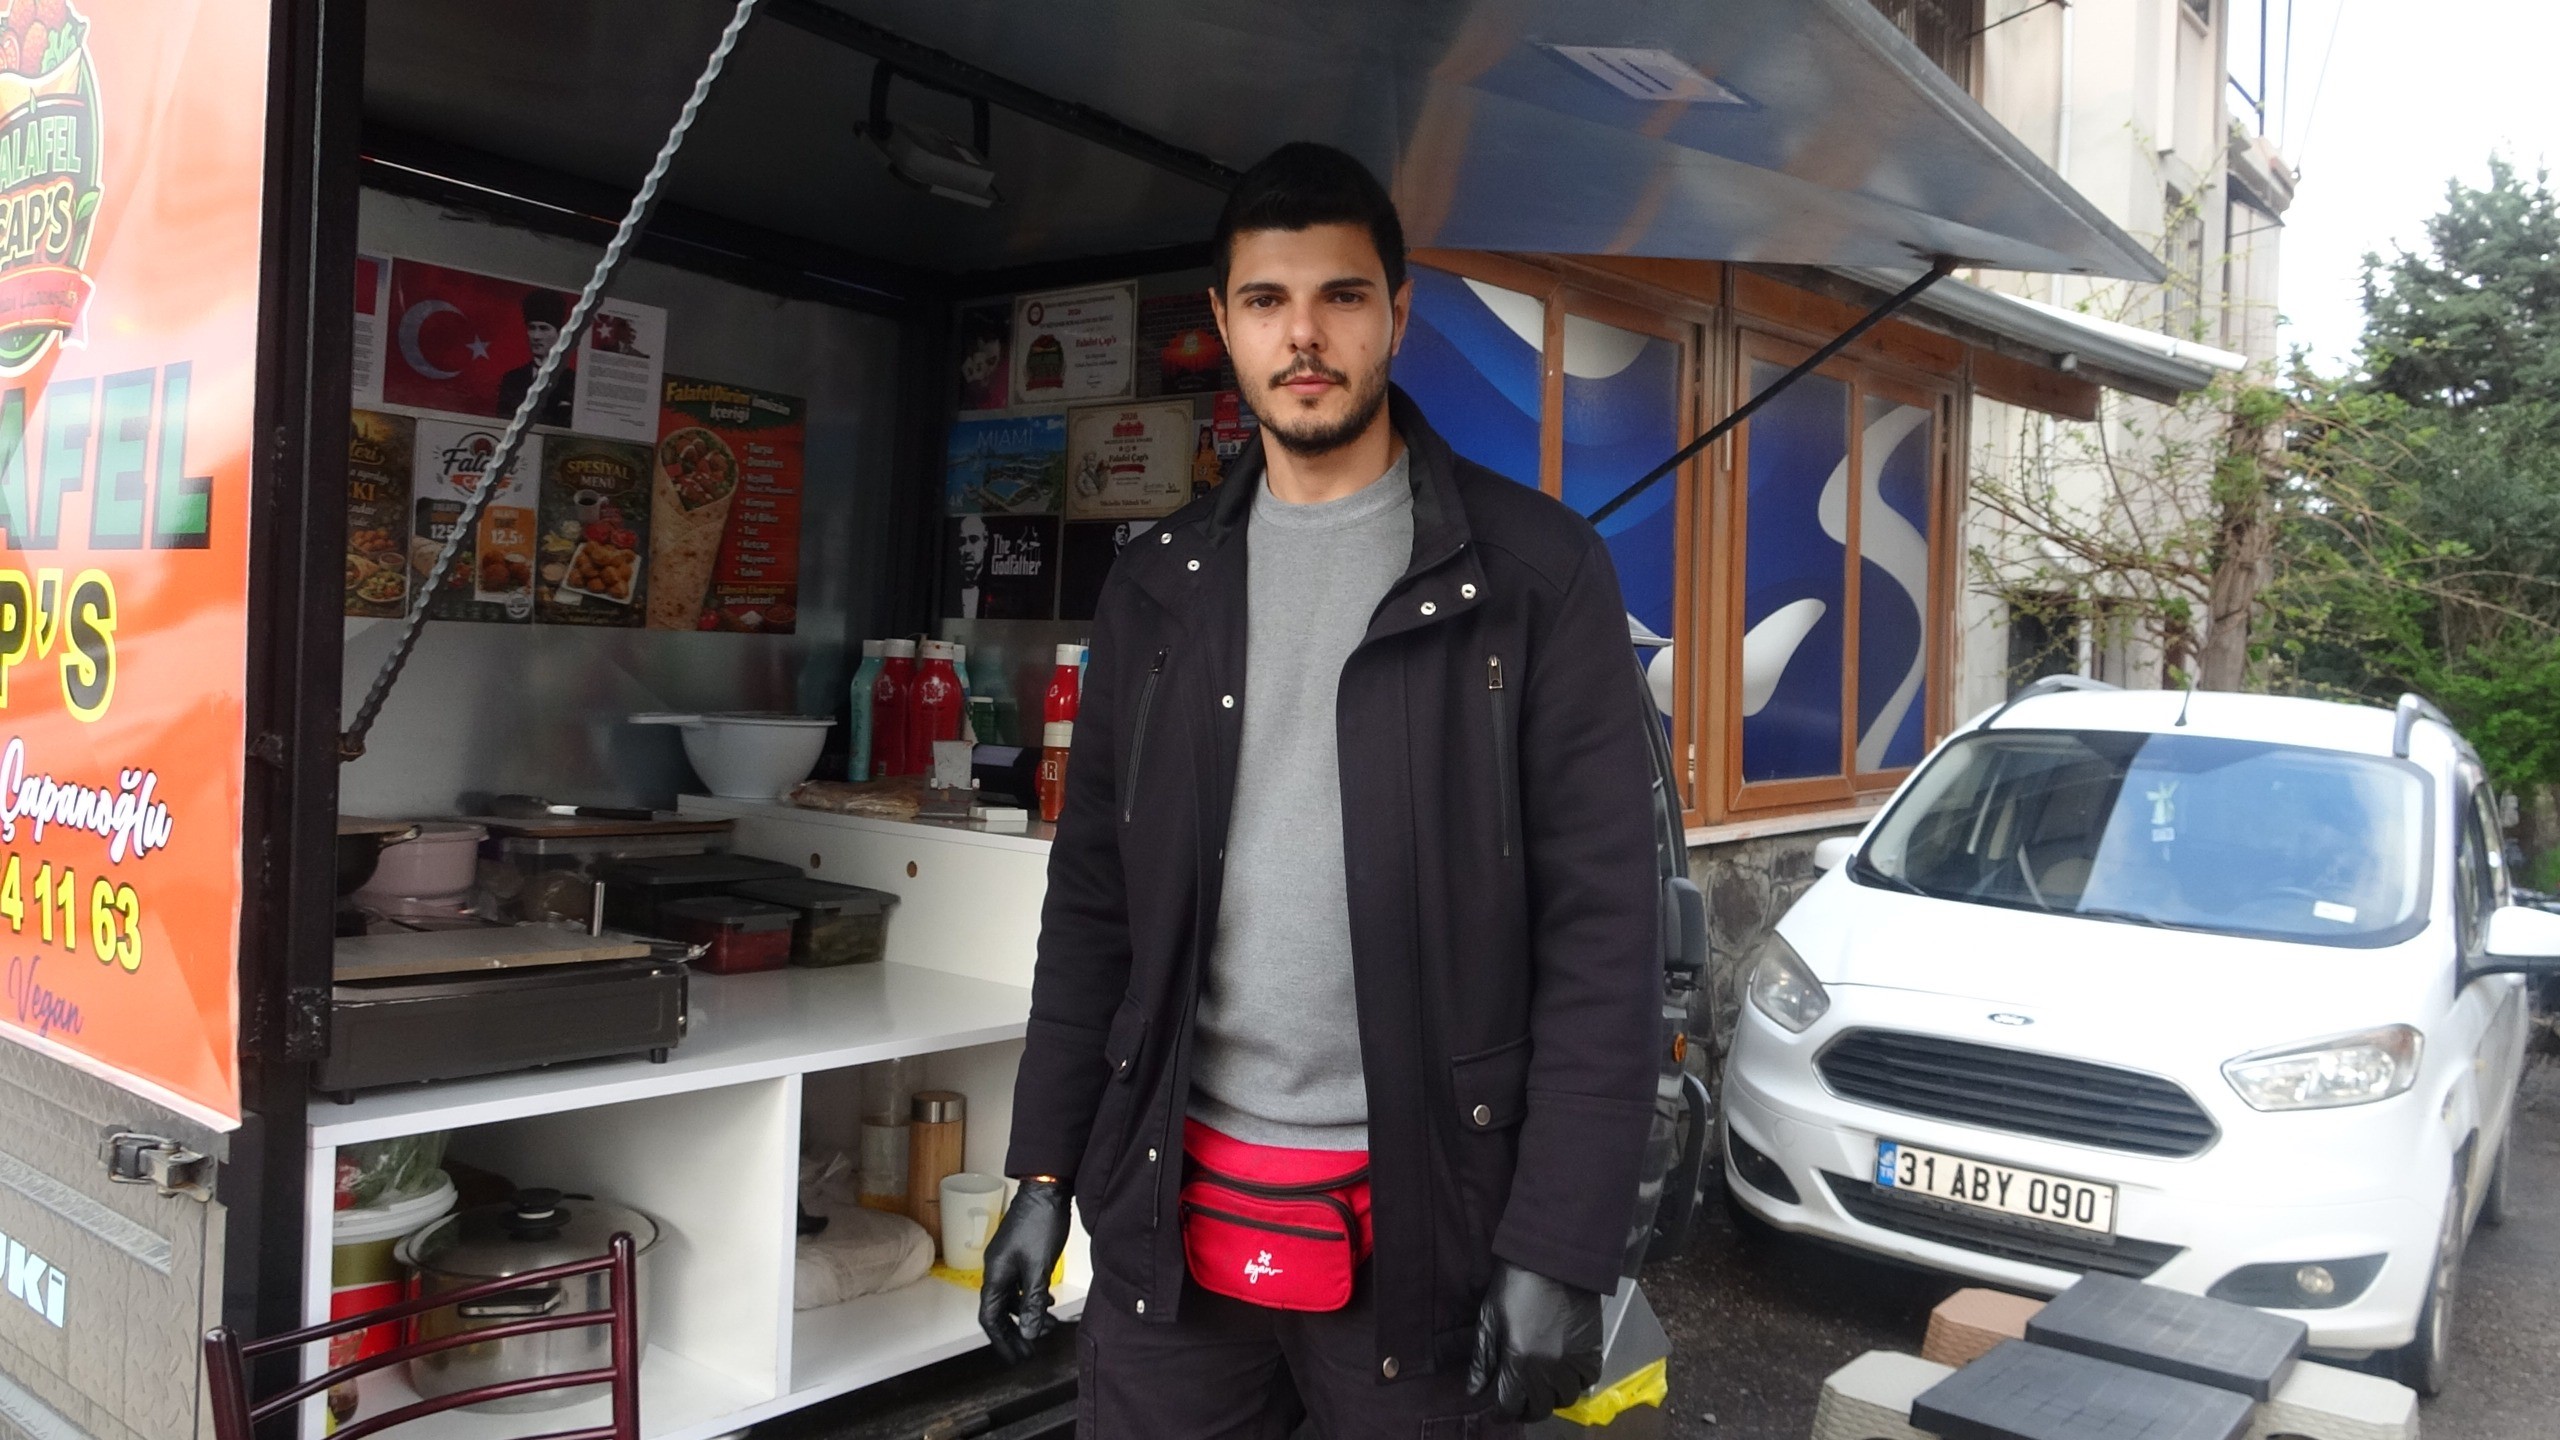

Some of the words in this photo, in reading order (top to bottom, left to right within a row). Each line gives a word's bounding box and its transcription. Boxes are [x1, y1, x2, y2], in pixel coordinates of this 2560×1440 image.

[977, 426, 1033, 449] MIAMI
[990, 554, 1042, 576] Godfather
[993, 534, 1011, 555] The
[0, 736, 173, 864] Çapanoğlu
[34, 860, 77, 952] 11
[91, 876, 143, 974] 63
[9, 955, 85, 1037] Vegan
[1899, 1152, 1936, 1191] 31
[1950, 1162, 2014, 1207] ABY
[2028, 1178, 2096, 1224] 090
